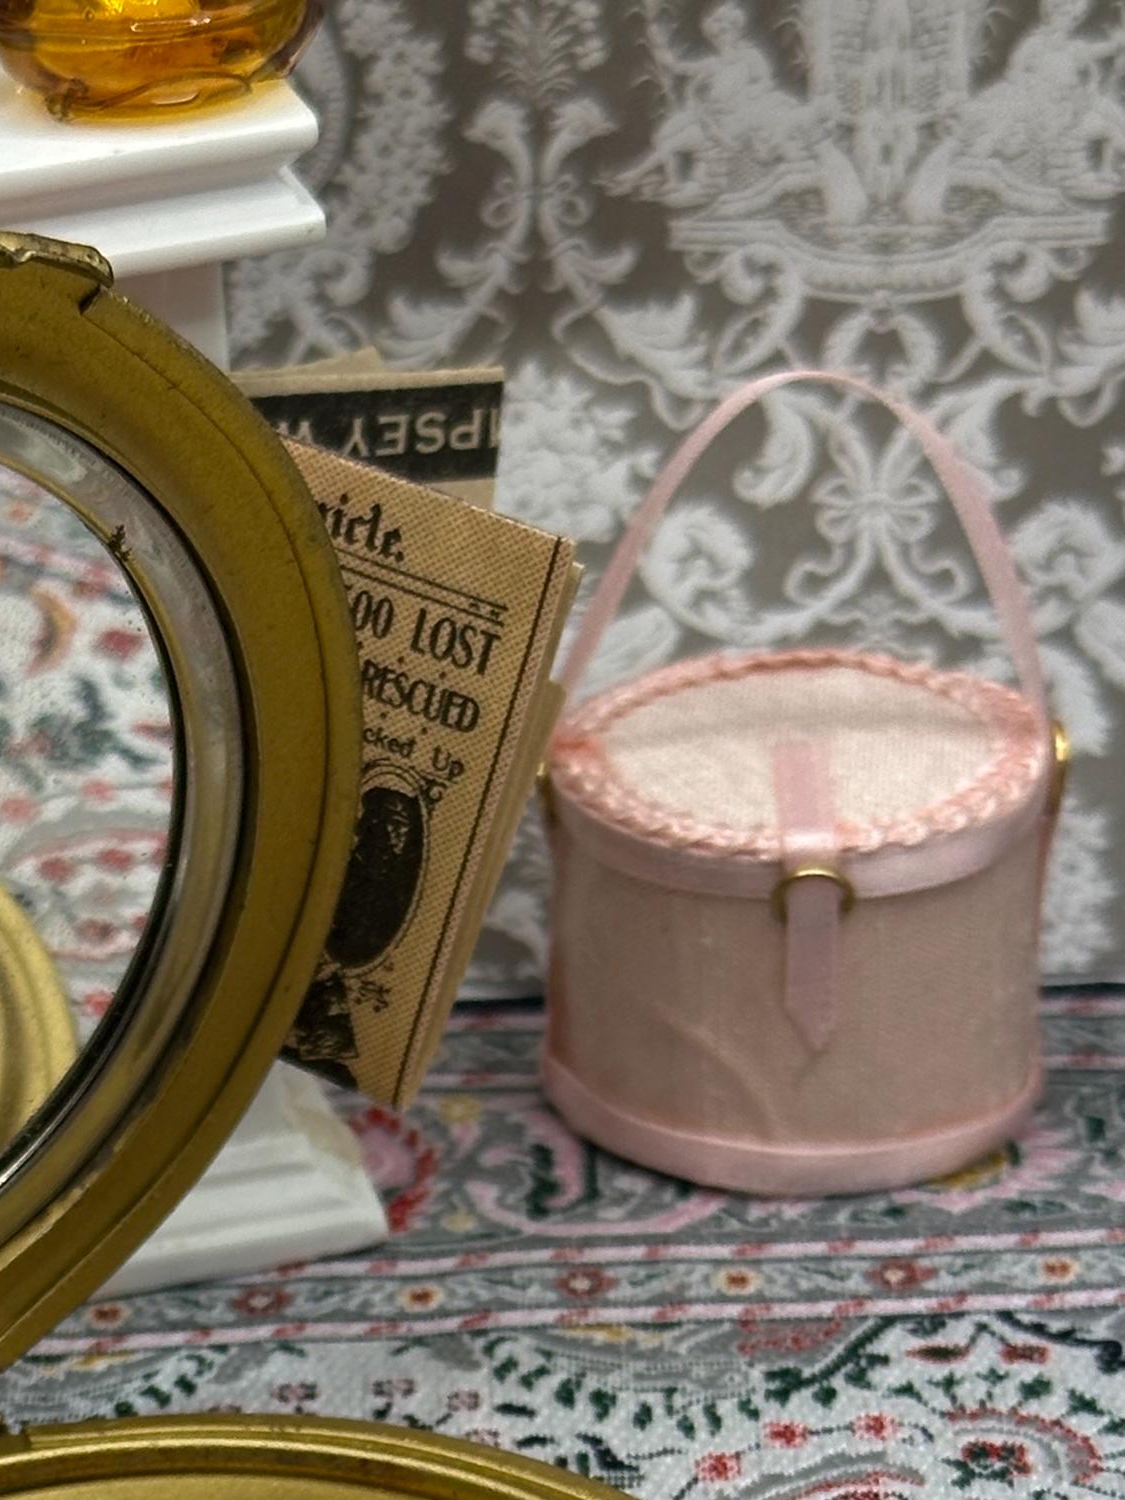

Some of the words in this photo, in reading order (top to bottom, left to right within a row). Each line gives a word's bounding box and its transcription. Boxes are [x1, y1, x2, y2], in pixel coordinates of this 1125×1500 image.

[345, 584, 394, 640] 00
[410, 607, 502, 676] LOST
[361, 659, 480, 733] RESCUED
[431, 745, 465, 784] Up
